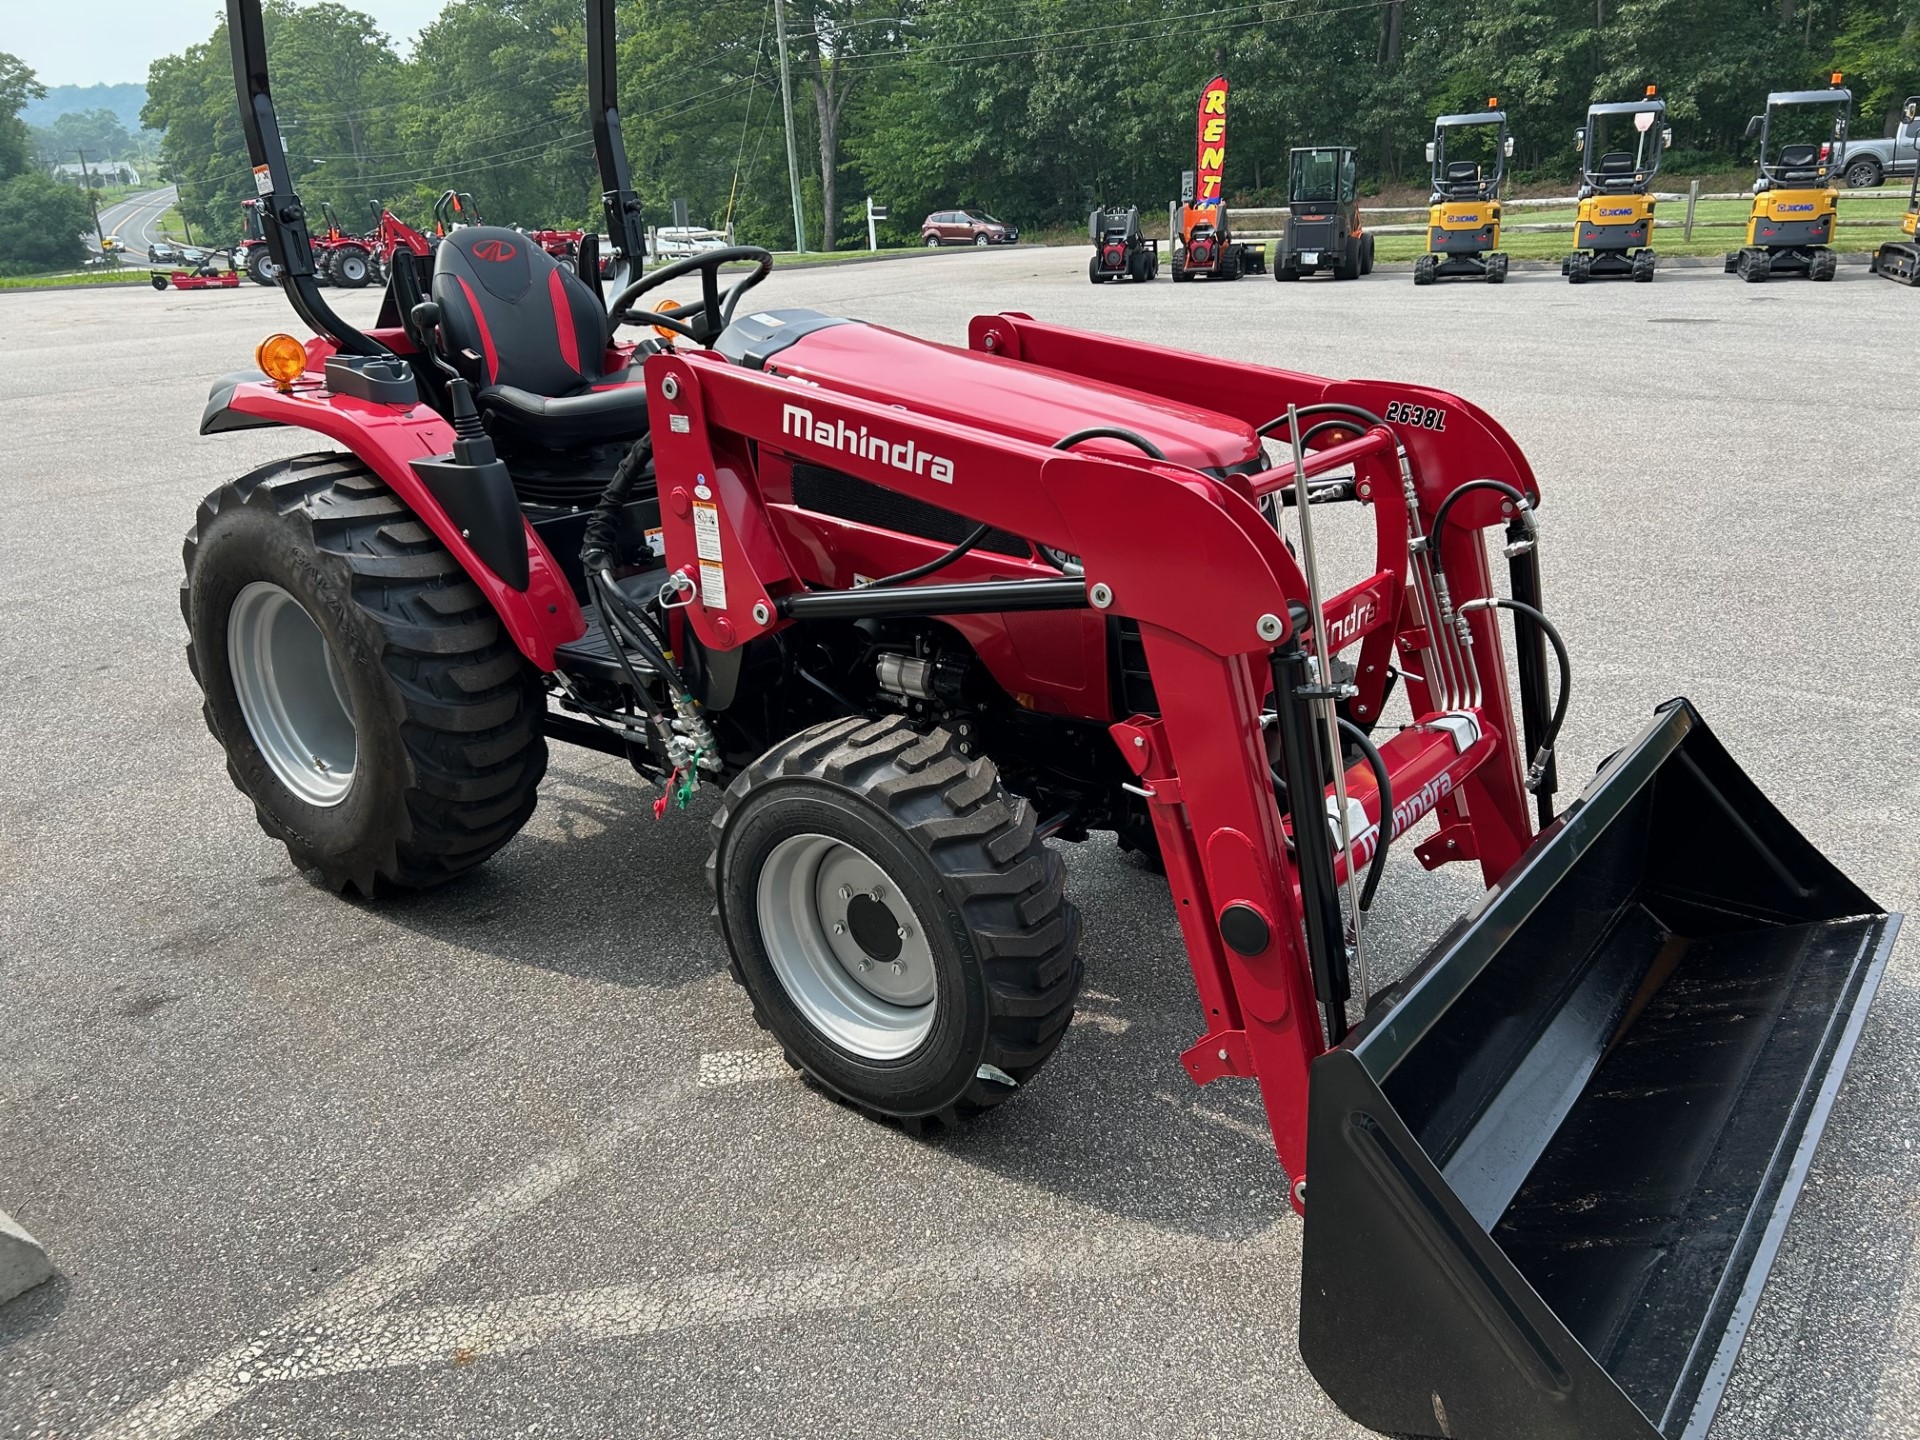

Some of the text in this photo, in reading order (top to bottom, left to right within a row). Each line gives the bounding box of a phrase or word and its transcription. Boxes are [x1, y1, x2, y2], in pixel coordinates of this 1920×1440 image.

[1201, 90, 1226, 198] RENT
[1183, 187, 1193, 198] 45
[1787, 204, 1814, 212] XCMG
[1607, 208, 1633, 216] XCMG
[1385, 401, 1446, 432] 2638L
[782, 403, 954, 485] Mahindra
[1325, 602, 1376, 648] indra
[1358, 772, 1452, 862] Mhindra
